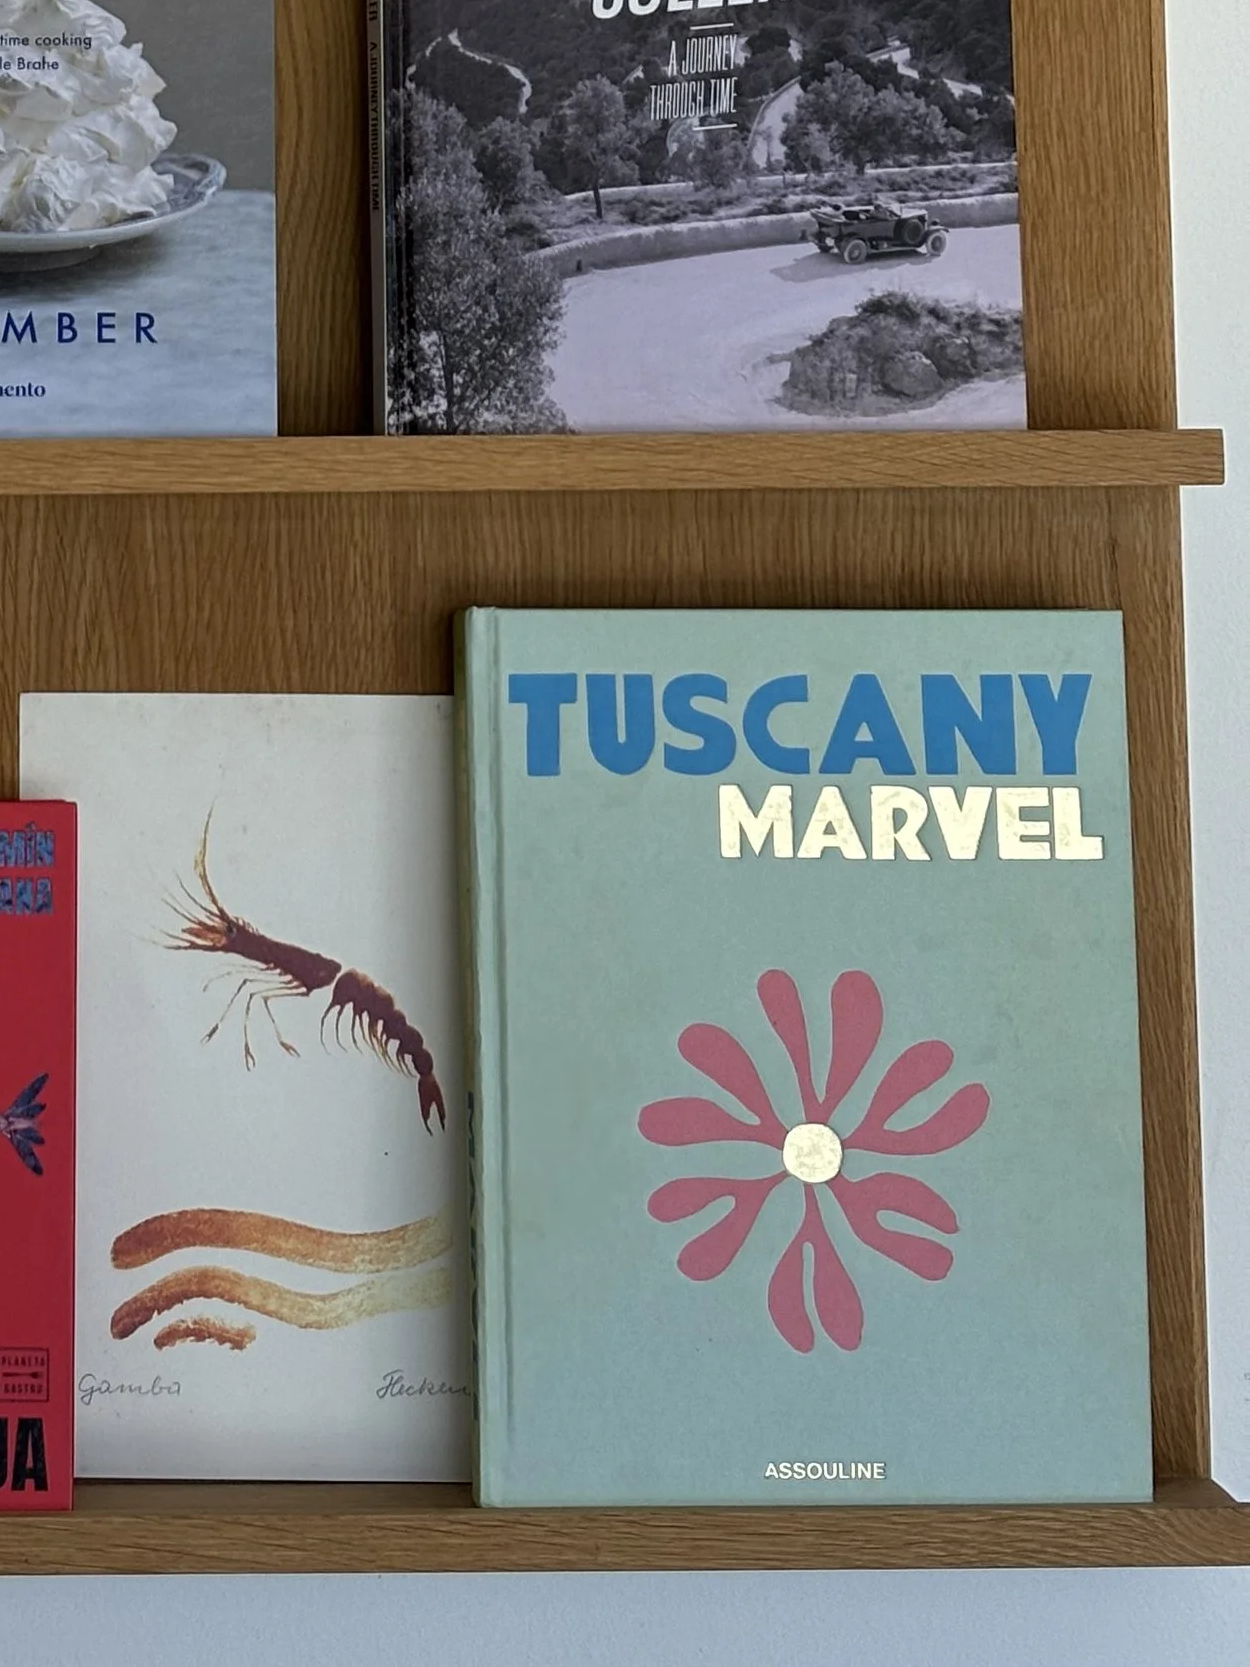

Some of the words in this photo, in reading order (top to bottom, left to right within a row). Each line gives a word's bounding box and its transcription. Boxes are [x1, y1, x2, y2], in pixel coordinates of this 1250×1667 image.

[35, 32, 92, 49] cooking
[668, 40, 678, 77] A
[681, 34, 737, 74] JOURNEY
[17, 55, 60, 70] Brahe
[650, 80, 705, 121] THROUGH
[710, 76, 738, 116] TIME
[507, 672, 1093, 777] TUSCANY
[719, 784, 1105, 862] MARVEL
[78, 1374, 181, 1406] Gamba
[764, 1462, 886, 1481] ASSOULINE
